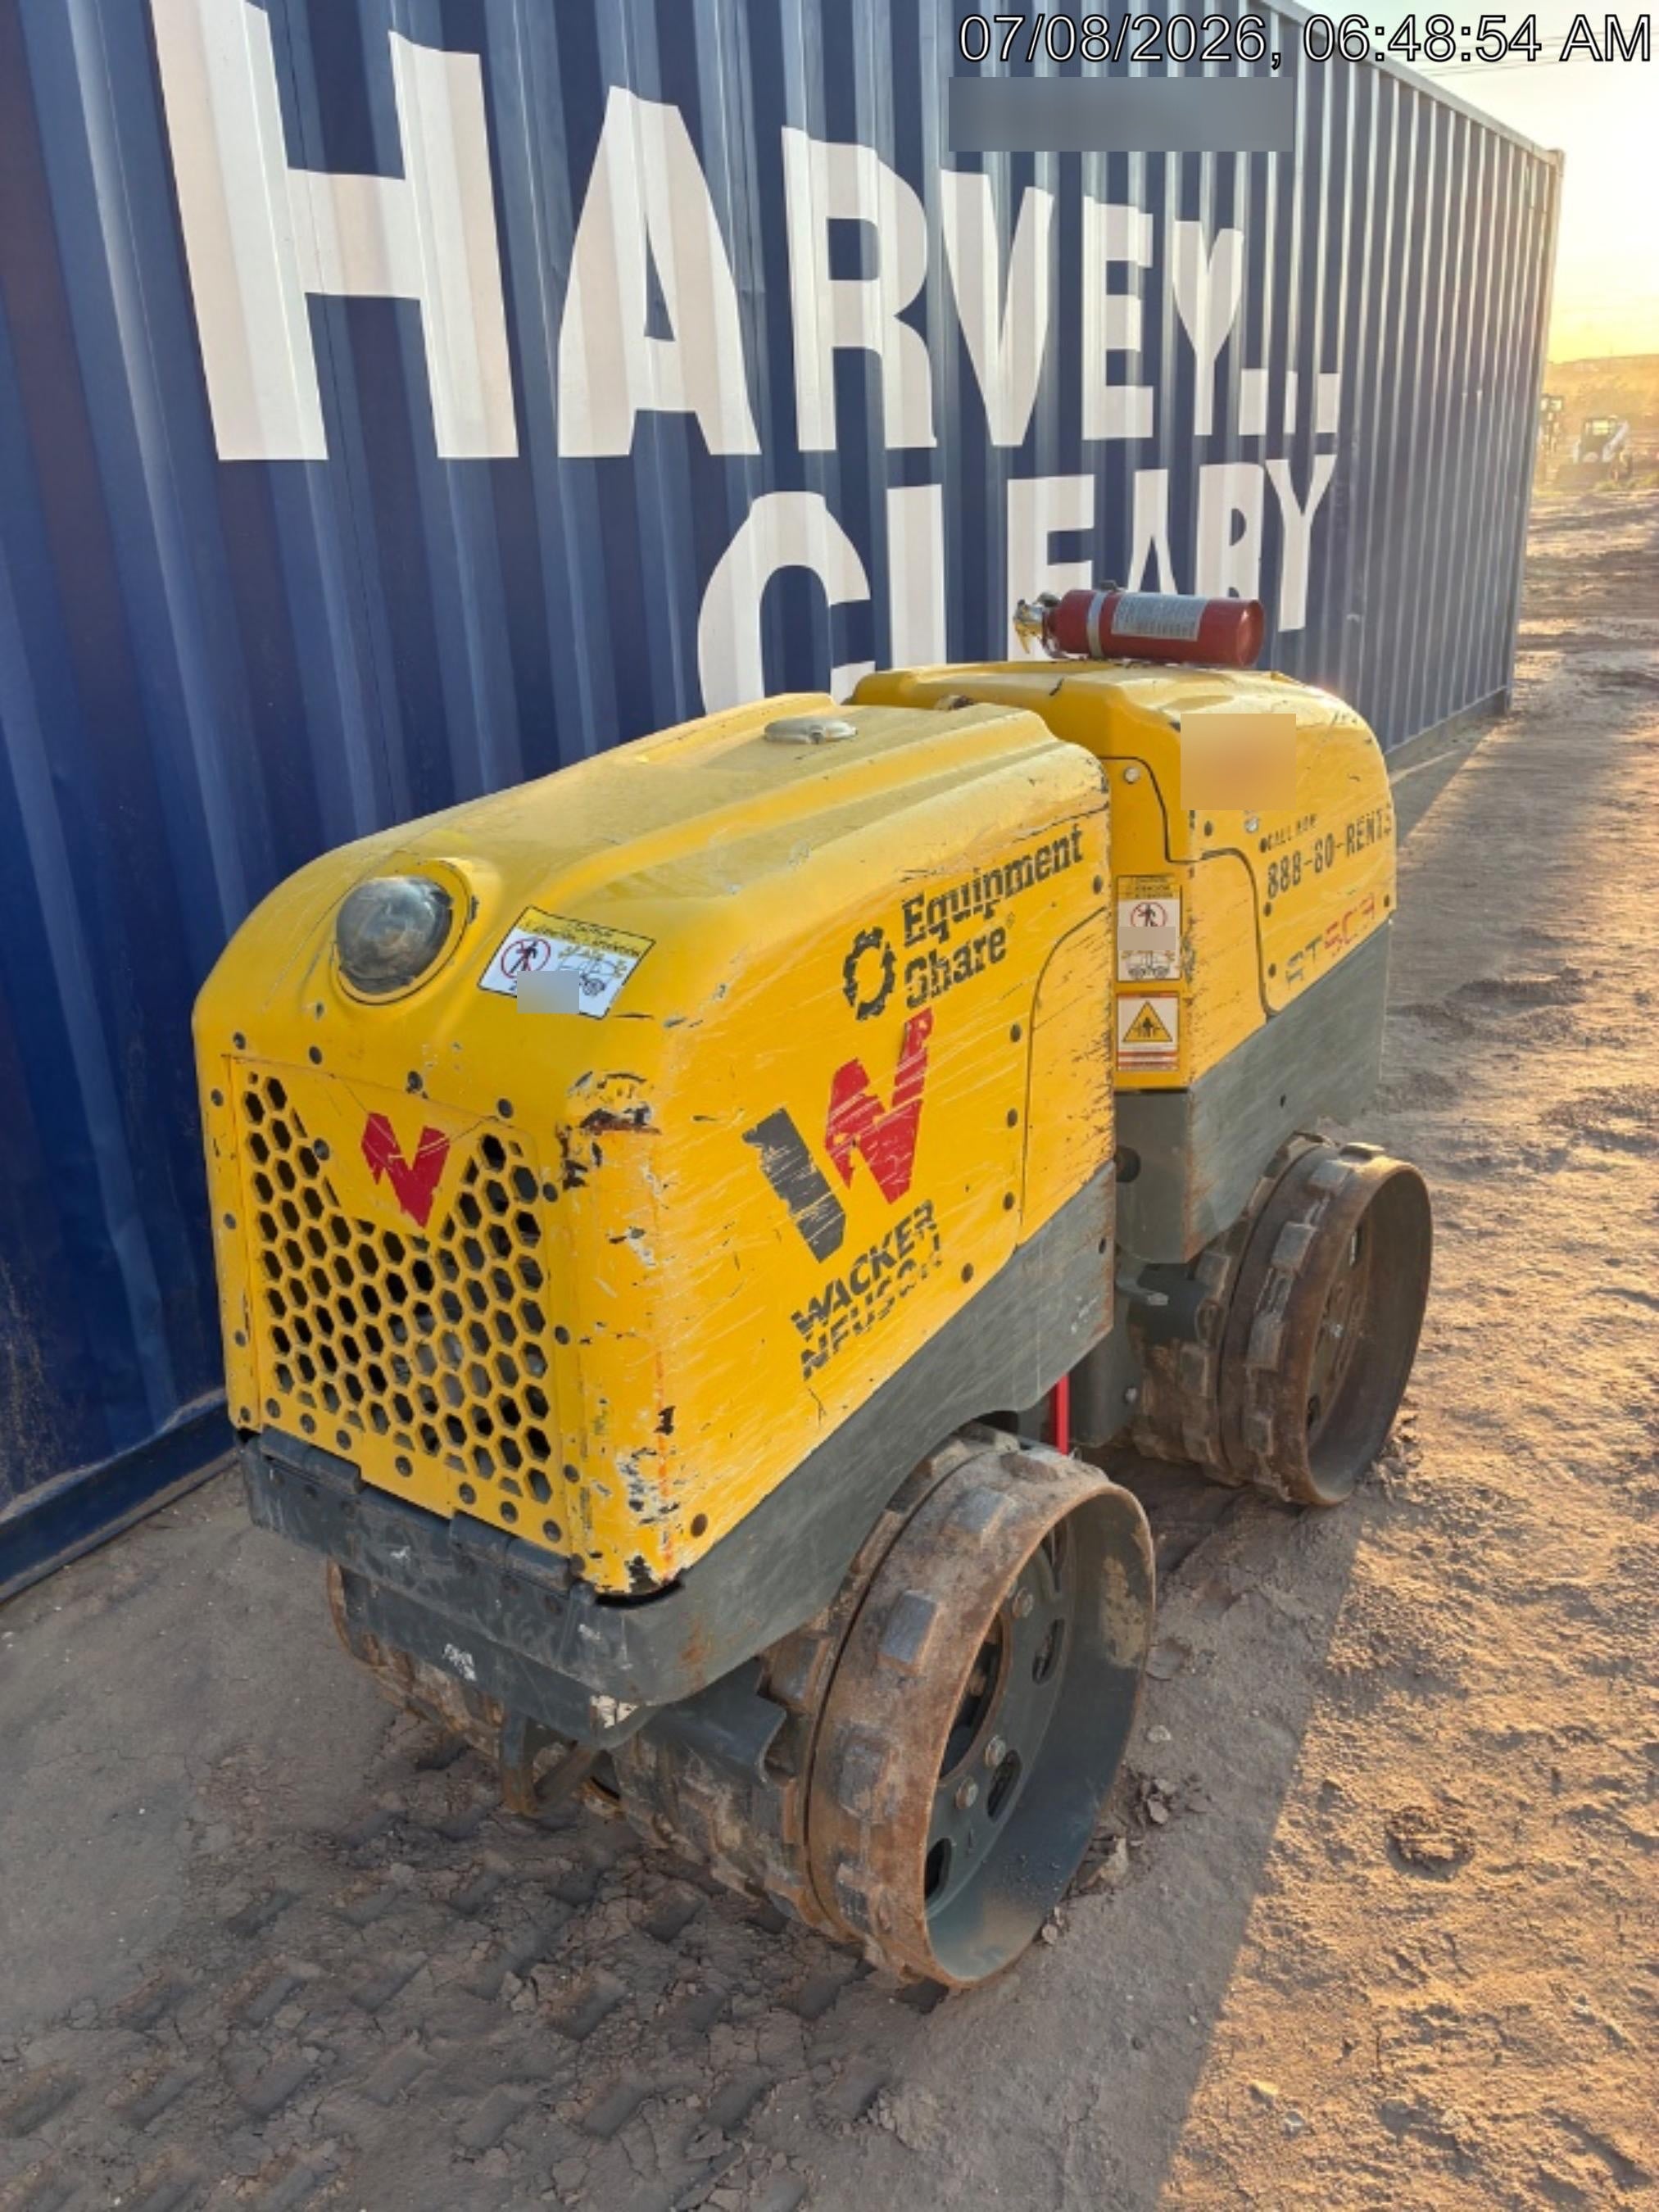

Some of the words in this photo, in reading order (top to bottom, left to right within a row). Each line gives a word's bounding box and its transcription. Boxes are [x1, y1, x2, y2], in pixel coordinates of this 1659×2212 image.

[901, 823, 1083, 944] Equipment
[904, 926, 1007, 1009] Share
[791, 1199, 937, 1342] WACKER
